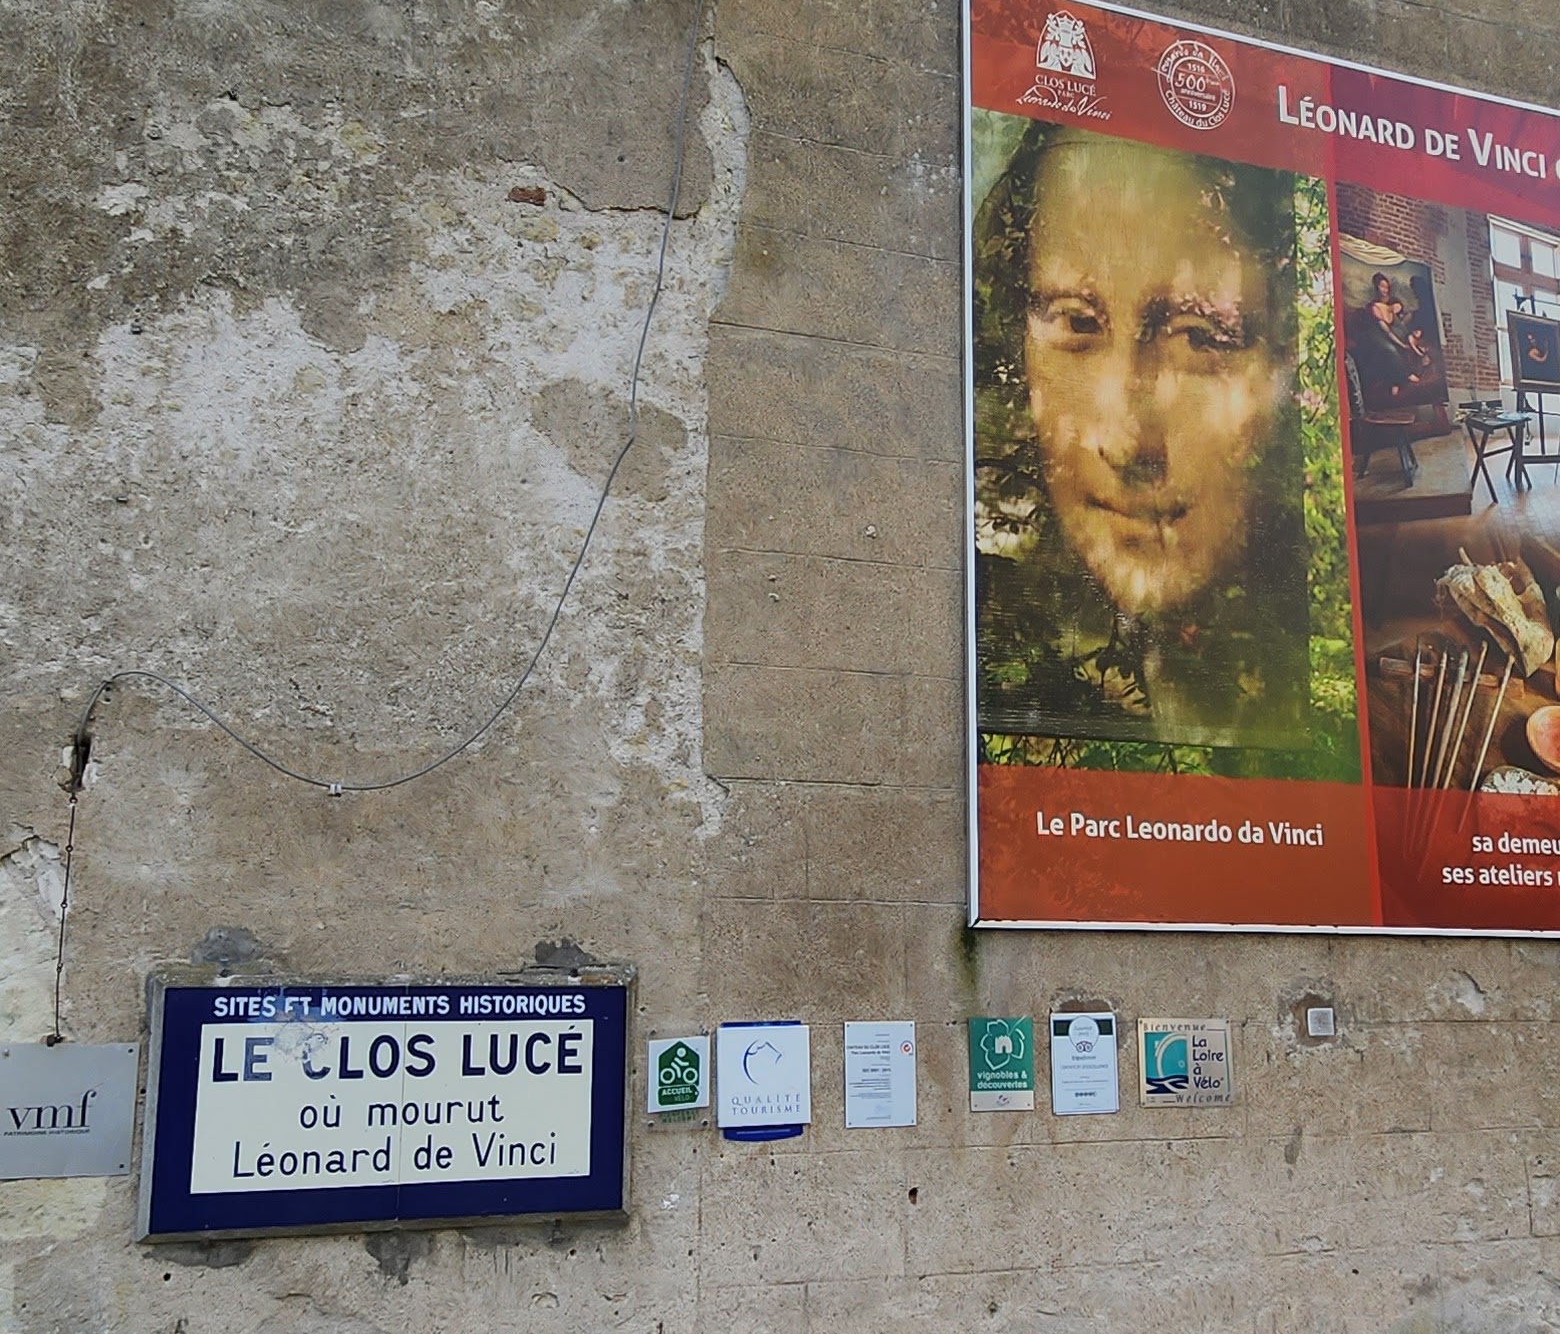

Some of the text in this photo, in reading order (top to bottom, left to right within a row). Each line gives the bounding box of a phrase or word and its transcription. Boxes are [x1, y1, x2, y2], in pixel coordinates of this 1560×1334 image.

[1035, 74, 1097, 97] CLOS LUCÉ
[1425, 128, 1460, 161] DE
[1037, 811, 1324, 846] Le Parc Leonardo da Vinci
[1472, 836, 1493, 852] sa
[1442, 866, 1475, 884] ses
[1479, 863, 1553, 887] ateliers
[214, 996, 276, 1017] SITES
[320, 995, 450, 1016] MONUMENTS
[460, 994, 586, 1016] HISTORIQUES
[1143, 1023, 1206, 1031] Bienvenue
[1192, 1035, 1207, 1048] La
[212, 1025, 583, 1082] LE CLOS LUCÉ
[1192, 1049, 1225, 1062] Loire
[977, 1070, 1028, 1081] vignobles &
[1192, 1062, 1203, 1076] à
[661, 1087, 693, 1097] ACCUEIL
[976, 1080, 1028, 1090] découvertes
[1175, 1092, 1231, 1103] Welcome
[7, 1089, 97, 1130] vmf
[300, 1094, 505, 1129] où mourut
[732, 1105, 801, 1116] TOURISME
[233, 1131, 556, 1178] Léonard de Vinci
